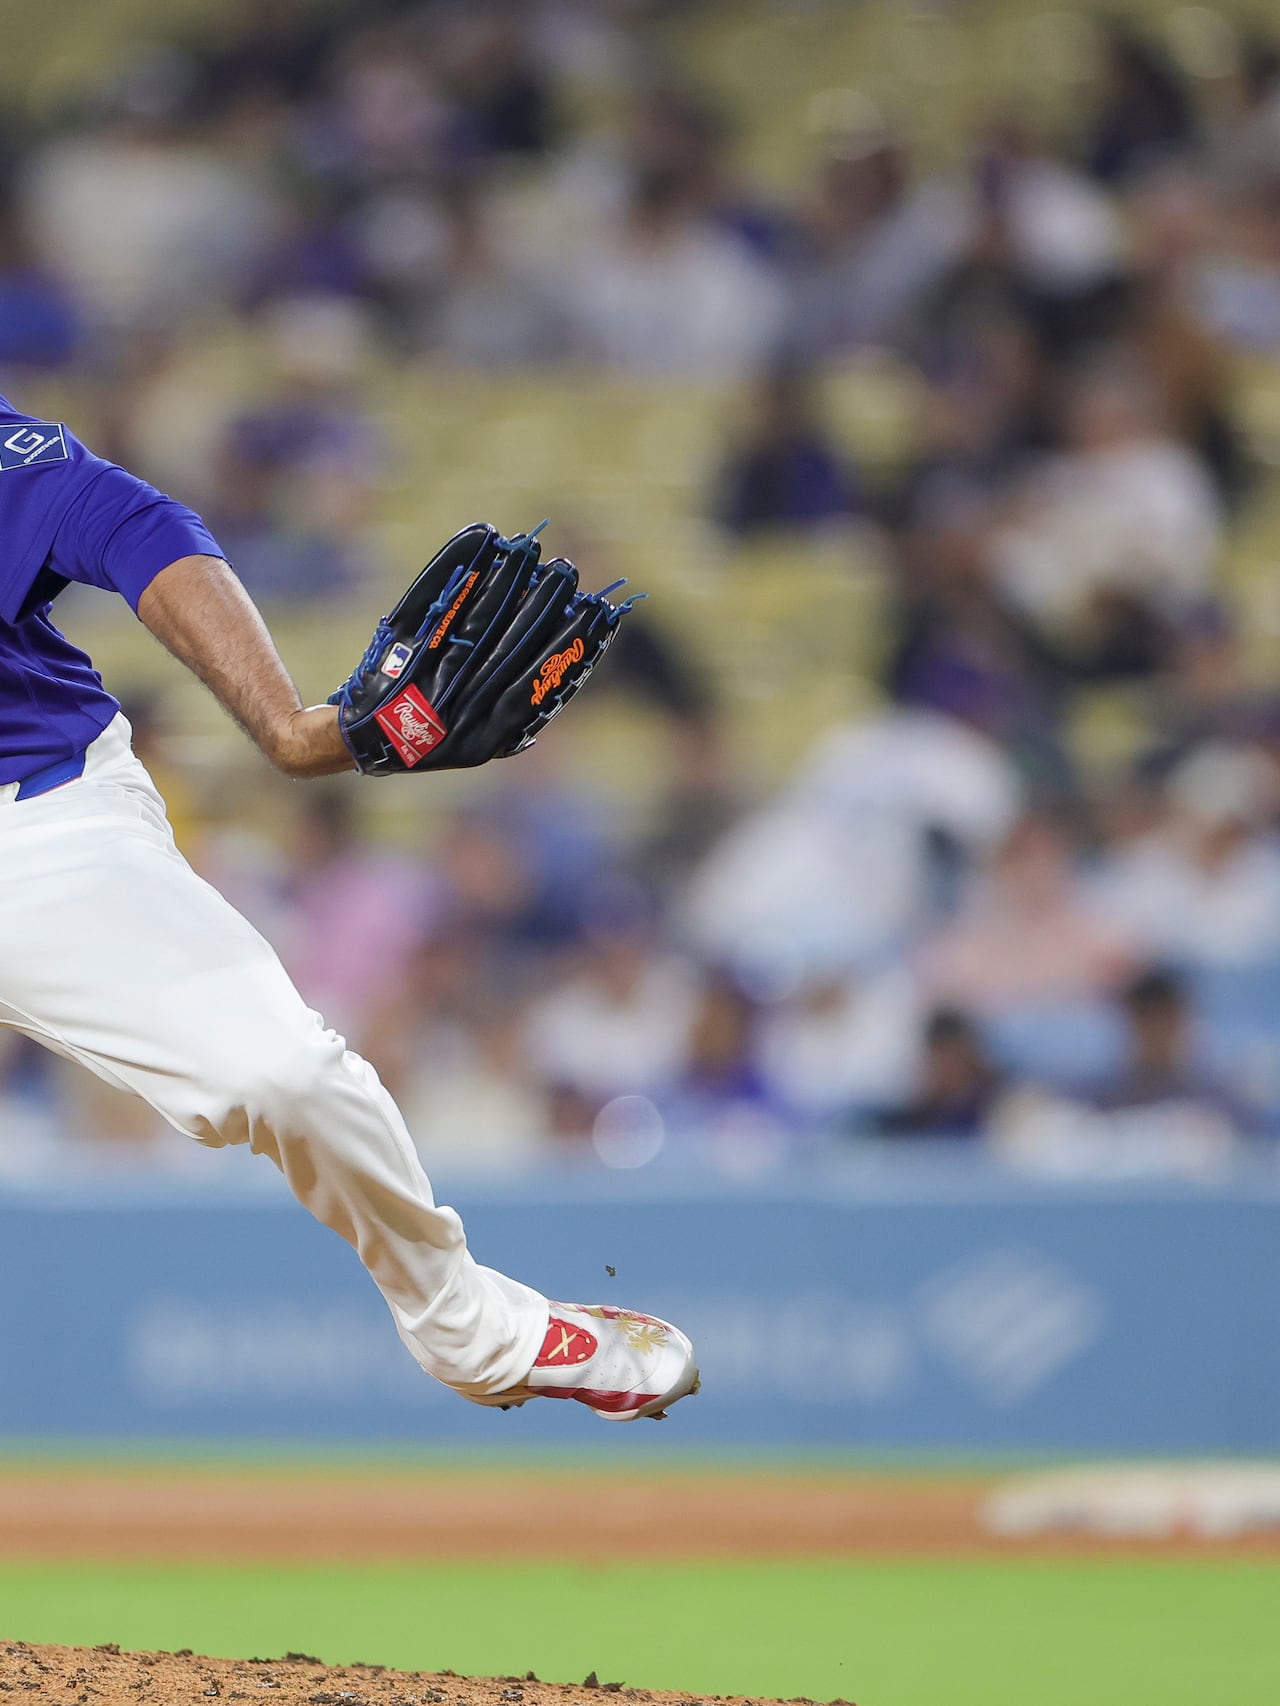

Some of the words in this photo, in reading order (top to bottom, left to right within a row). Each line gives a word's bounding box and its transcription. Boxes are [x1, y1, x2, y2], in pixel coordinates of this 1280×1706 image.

[452, 587, 470, 610] GOLD
[436, 609, 457, 637] GLOVE
[531, 637, 585, 706] Rawlings
[393, 701, 436, 746] Rawlings
